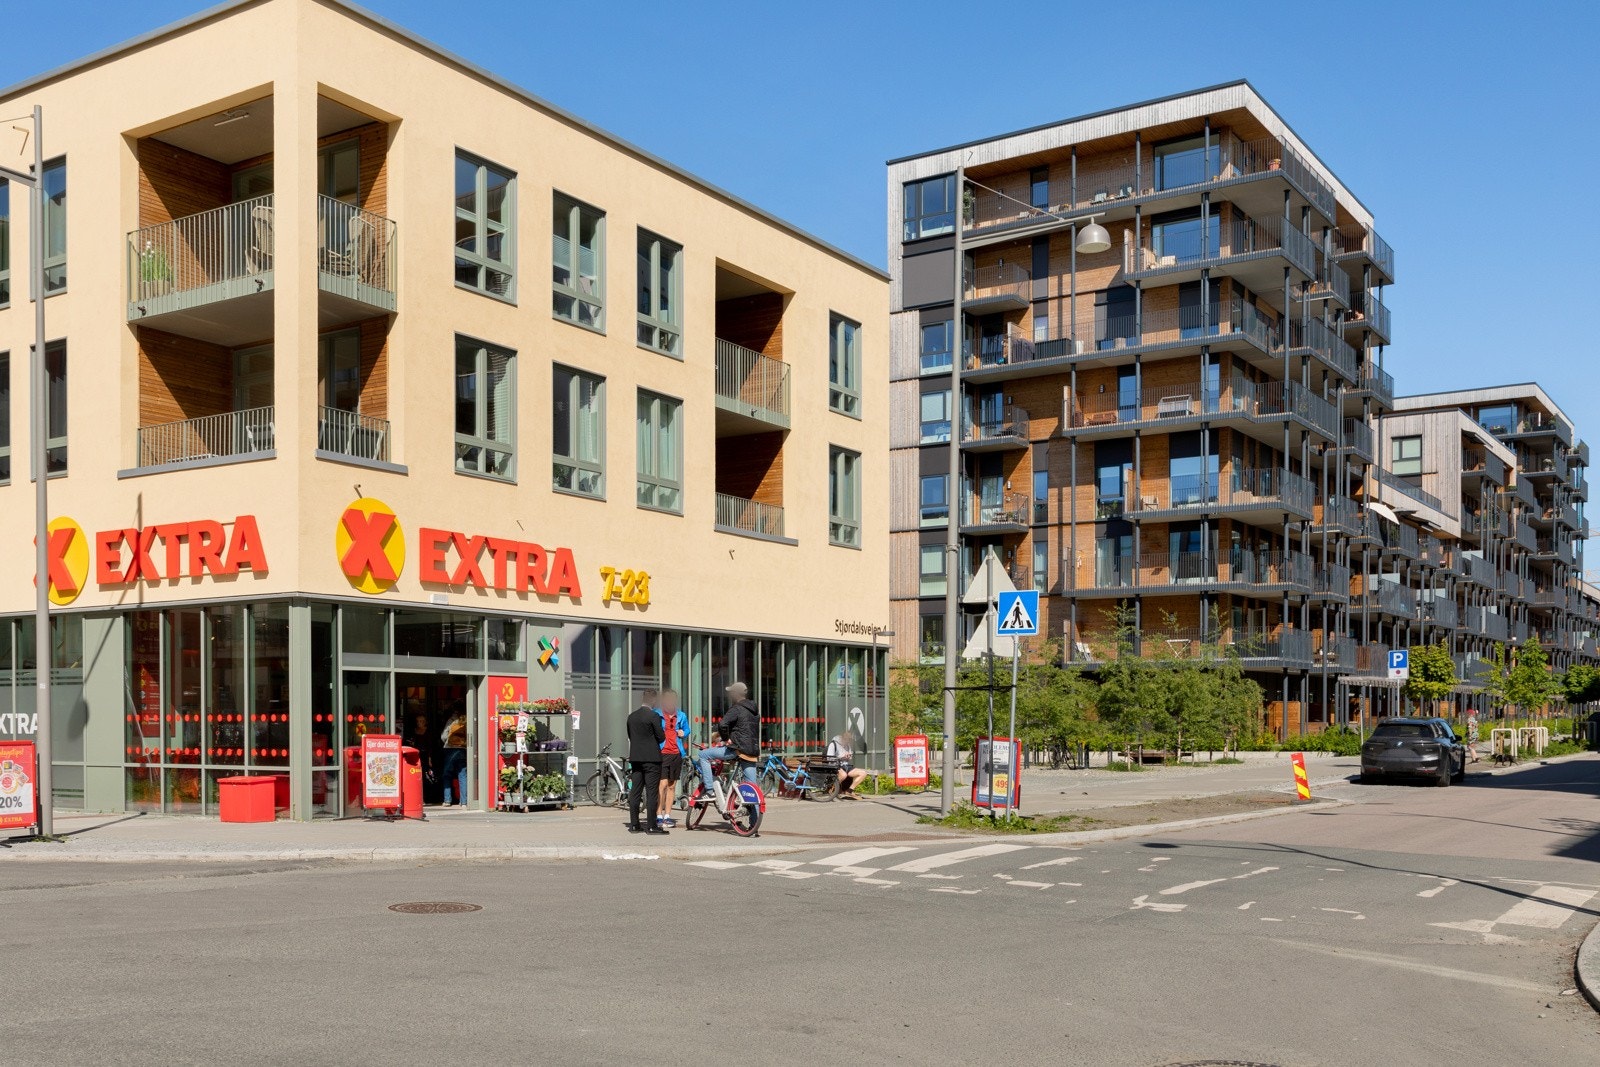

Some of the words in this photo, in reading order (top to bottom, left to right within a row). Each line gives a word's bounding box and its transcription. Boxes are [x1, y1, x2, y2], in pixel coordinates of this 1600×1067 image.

[33, 527, 78, 597] X
[96, 515, 268, 585] EXTRA
[341, 508, 397, 581] X
[419, 527, 582, 597] EXTRA
[600, 566, 649, 605] 7-23
[835, 619, 881, 636] Stjørdalsveien
[1393, 653, 1404, 667] P
